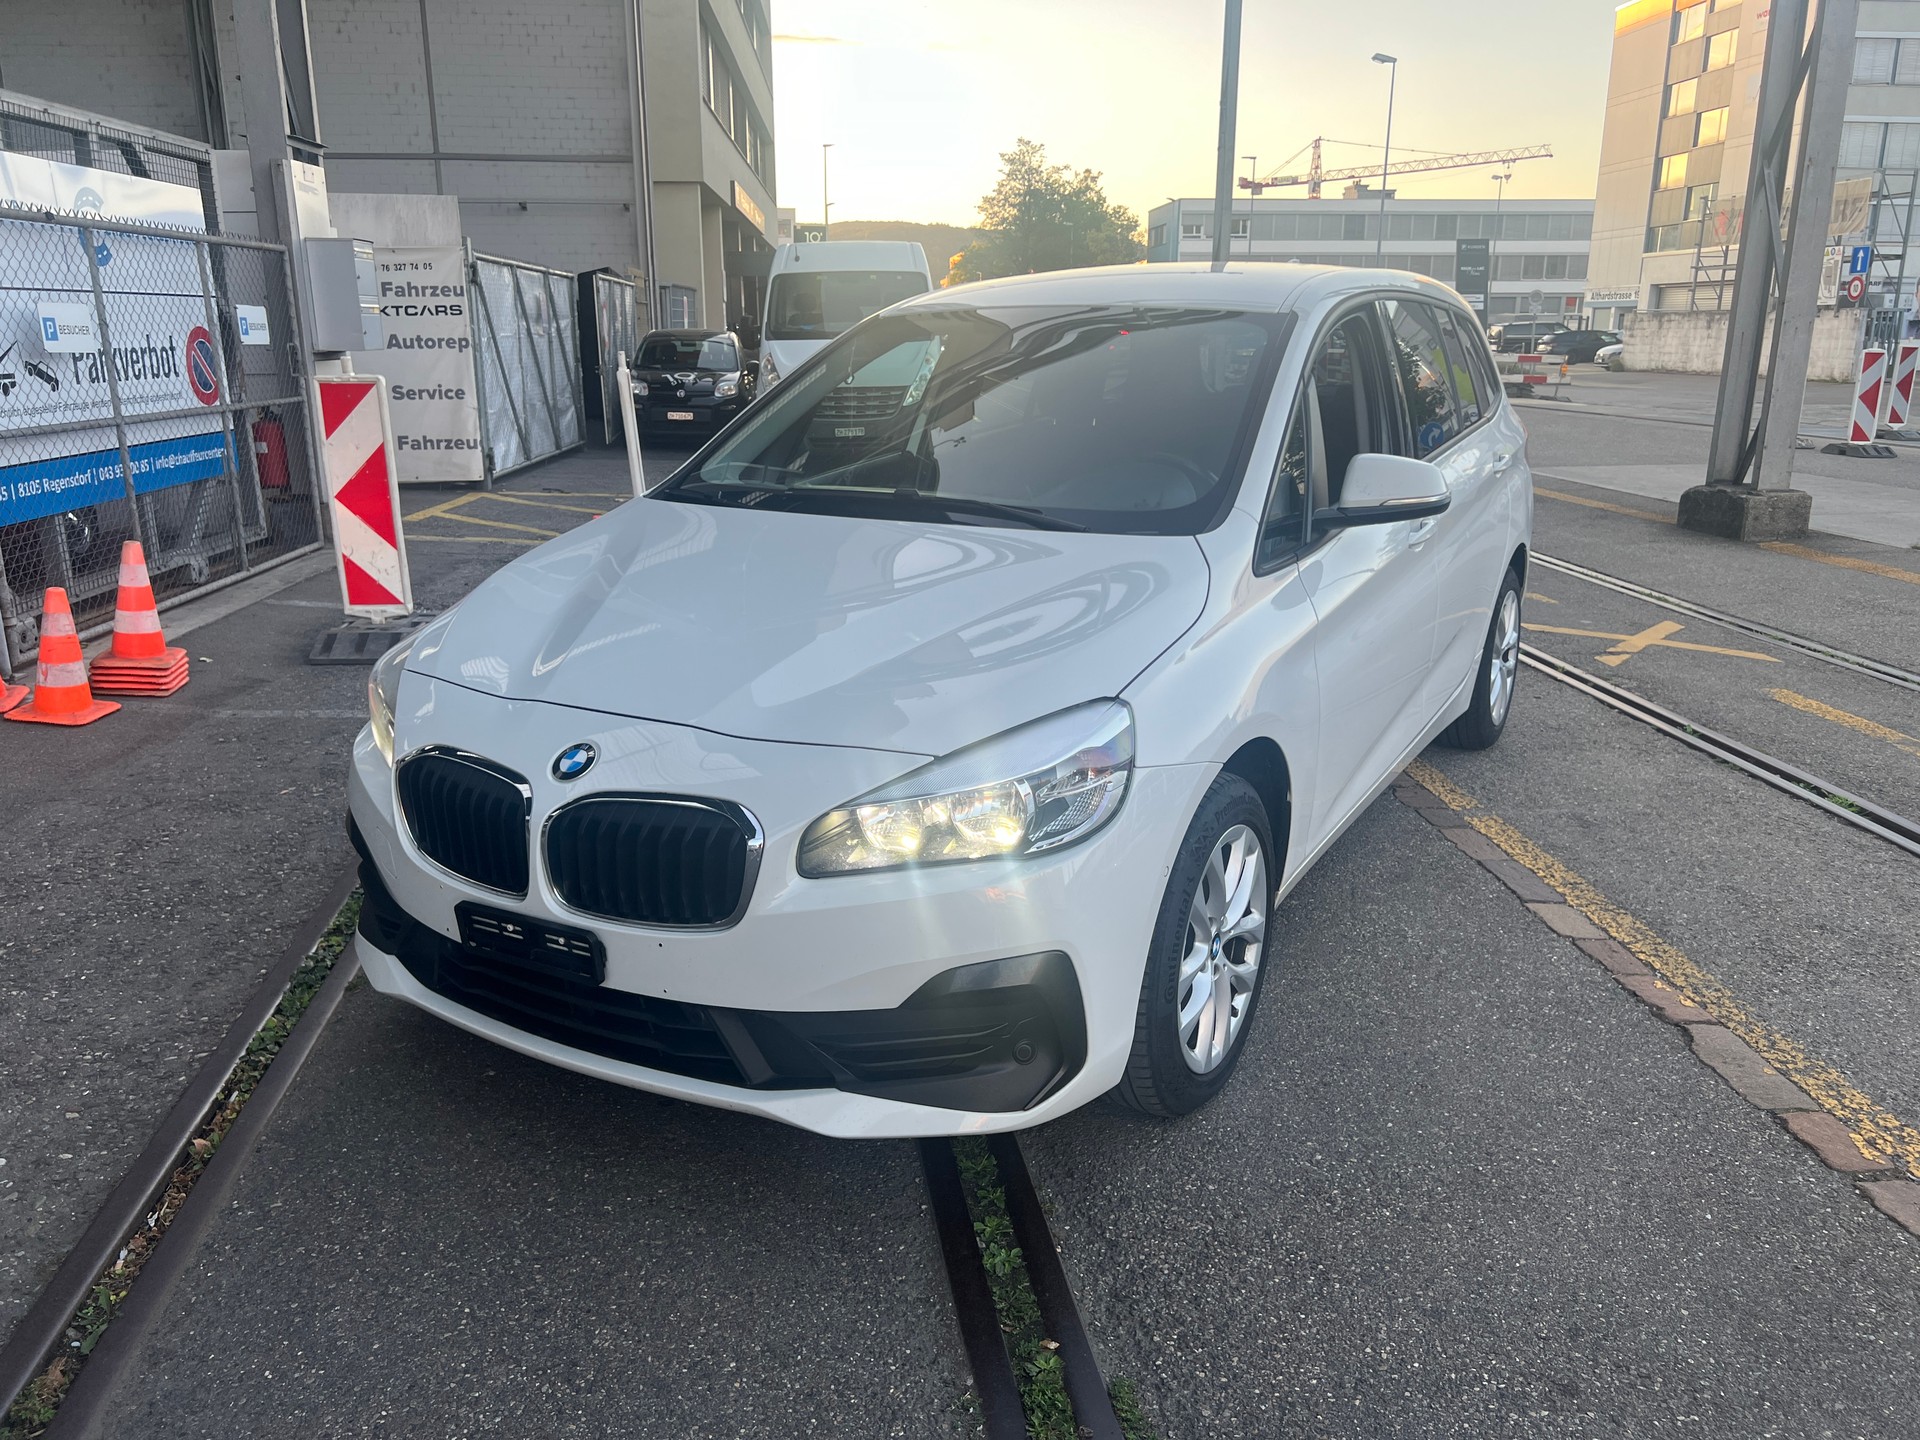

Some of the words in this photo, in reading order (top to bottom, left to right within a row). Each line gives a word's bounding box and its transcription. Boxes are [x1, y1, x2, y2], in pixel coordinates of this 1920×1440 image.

[394, 263, 406, 272] 327
[410, 263, 419, 271] 74
[423, 262, 433, 270] 05
[1591, 292, 1632, 301] Althardstrasse
[58, 324, 91, 336] BESUCHER
[391, 384, 466, 401] Service
[397, 435, 481, 451] Fahrzeu
[17, 480, 42, 498] 8105
[43, 469, 92, 494] Regensdorf
[98, 464, 114, 481] 043
[140, 459, 150, 473] 85
